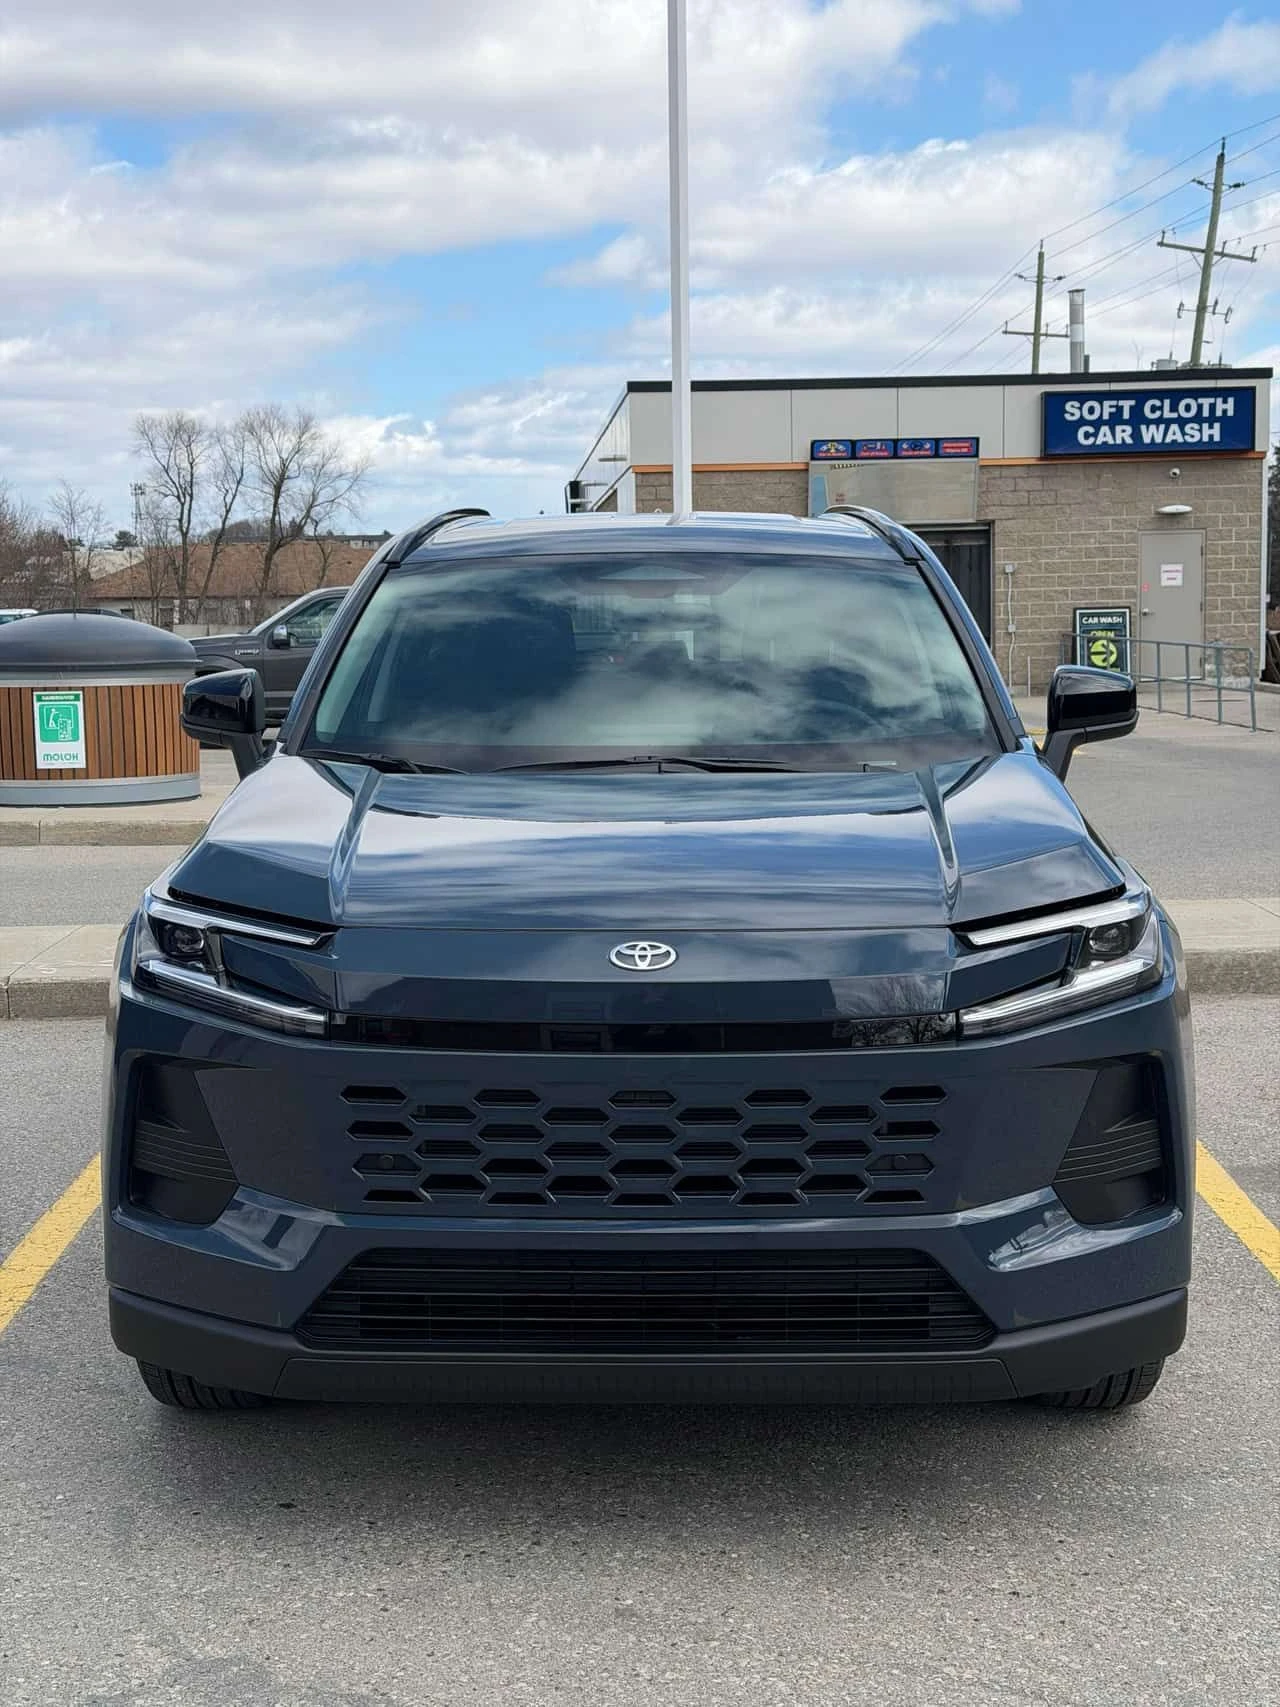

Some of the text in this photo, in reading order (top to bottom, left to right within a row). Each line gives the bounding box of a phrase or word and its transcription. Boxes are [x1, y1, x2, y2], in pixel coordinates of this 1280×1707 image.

[1064, 397, 1235, 421] SOFT CLOTH
[1077, 422, 1222, 445] CAR WASH
[1082, 616, 1123, 624] CAR WASH
